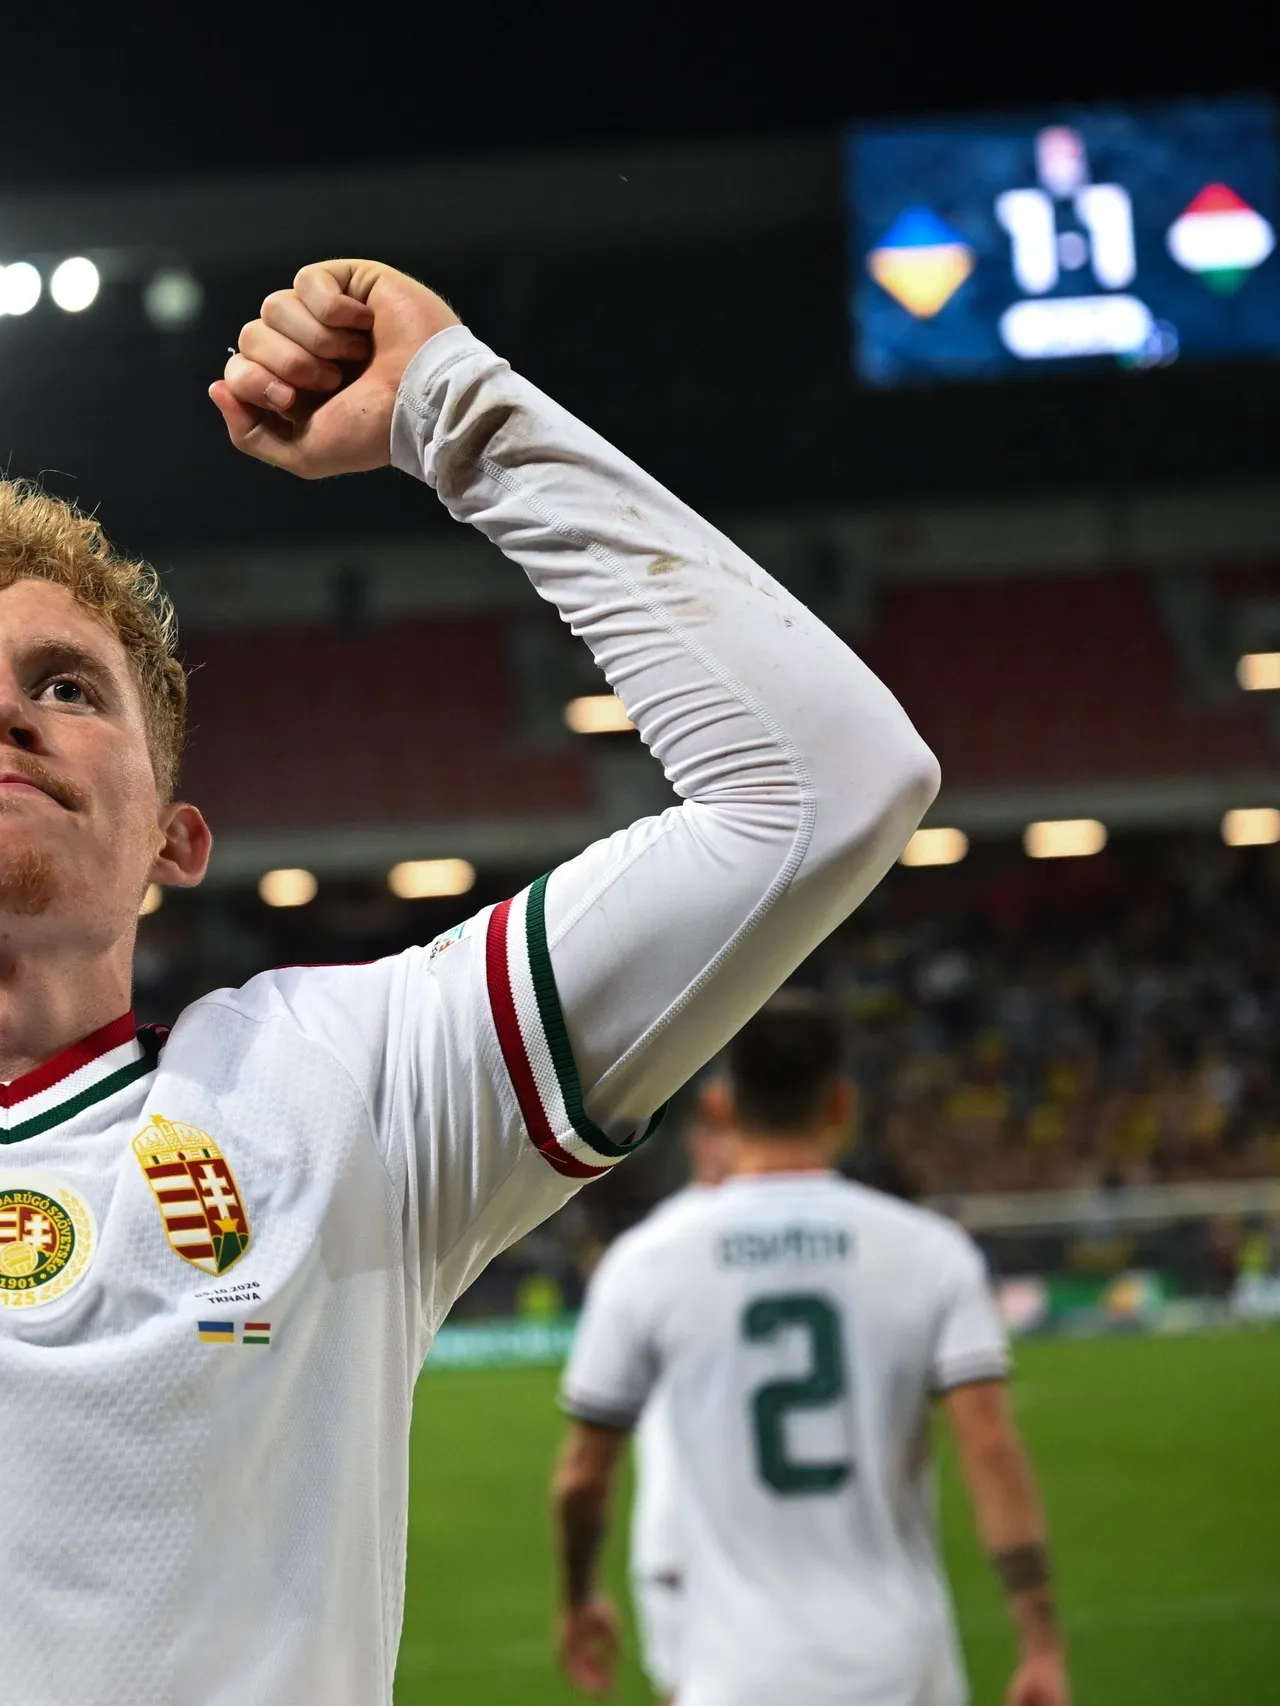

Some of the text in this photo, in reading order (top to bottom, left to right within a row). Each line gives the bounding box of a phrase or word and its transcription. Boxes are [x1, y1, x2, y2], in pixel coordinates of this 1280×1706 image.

[46, 1206, 72, 1274] SZÖVETSÉG
[0, 1291, 36, 1305] 125
[207, 1292, 261, 1304] TRNAVA
[741, 1291, 854, 1497] 2
